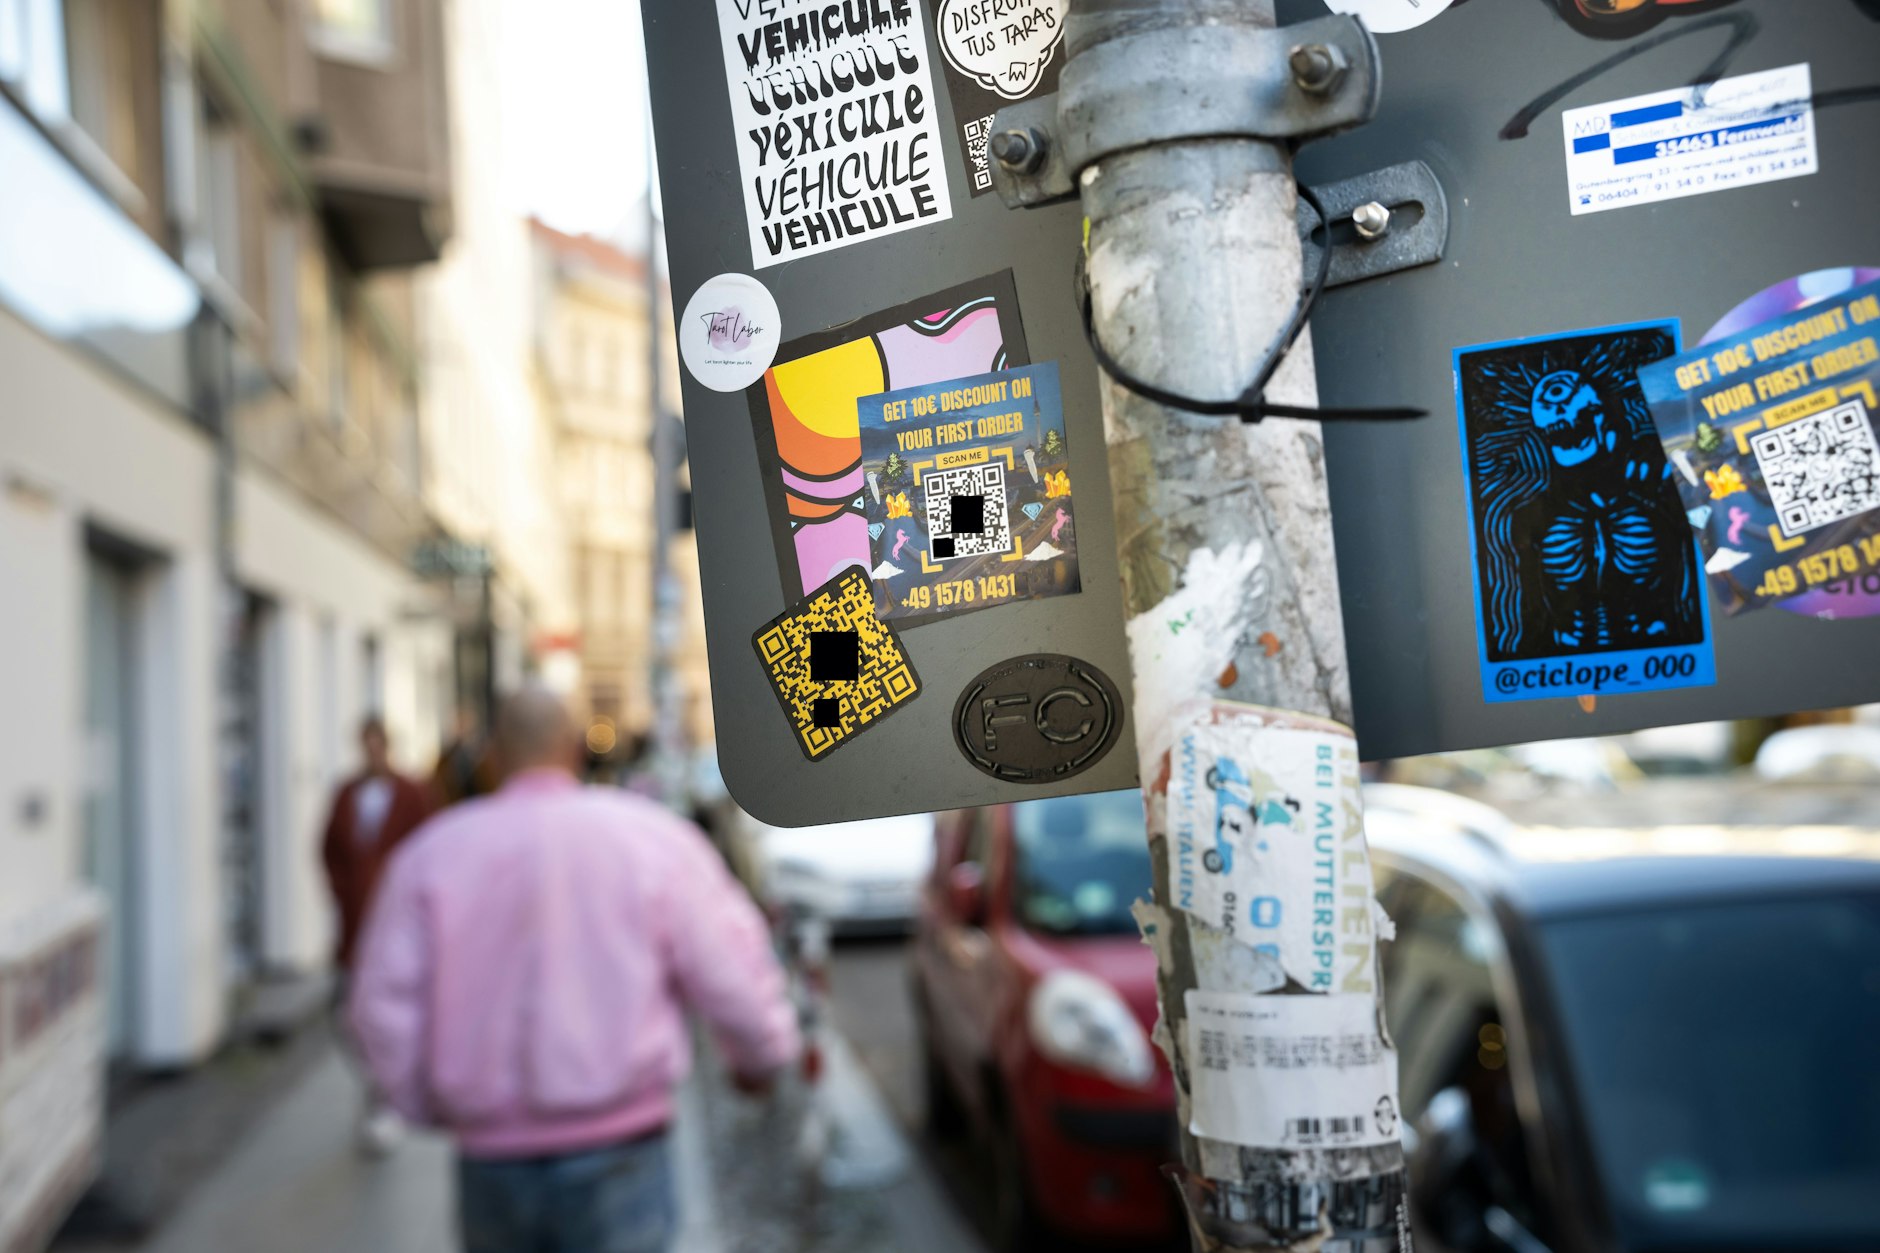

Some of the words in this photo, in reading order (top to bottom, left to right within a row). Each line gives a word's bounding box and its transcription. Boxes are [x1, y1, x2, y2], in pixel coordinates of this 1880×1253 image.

[962, 31, 995, 57] TUS
[1000, 7, 1056, 46] TARAS
[1573, 116, 1606, 136] MD
[1655, 133, 1715, 158] 35463
[1717, 117, 1804, 147] Fernwald
[755, 132, 930, 220] VÉHICULE
[761, 183, 938, 256] VÉHICULE
[1675, 358, 1711, 390] GET
[1713, 344, 1752, 376] 10€
[1752, 306, 1847, 361] DISCOUNT
[1849, 294, 1880, 325] ON
[883, 400, 907, 422] GET
[911, 394, 937, 417] 10€
[940, 381, 1008, 413] DISCOUNT
[1011, 377, 1032, 399] ON
[1701, 383, 1755, 419] YOUR
[1754, 361, 1810, 400] FIRST
[1811, 337, 1878, 380] ORDER
[896, 428, 933, 452] YOUR
[936, 420, 973, 445] FIRST
[978, 412, 1023, 438] ORDER
[942, 454, 967, 465] SCAN
[969, 451, 982, 461] ME
[901, 586, 930, 609] +49
[934, 579, 975, 606] 1578
[978, 573, 1017, 600] 1431
[1755, 565, 1797, 597] +49
[1797, 544, 1859, 585] 1578
[1495, 653, 1696, 694] @ciclope_000
[1316, 744, 1333, 788] BEI
[1312, 802, 1335, 988] MUTTERSPR
